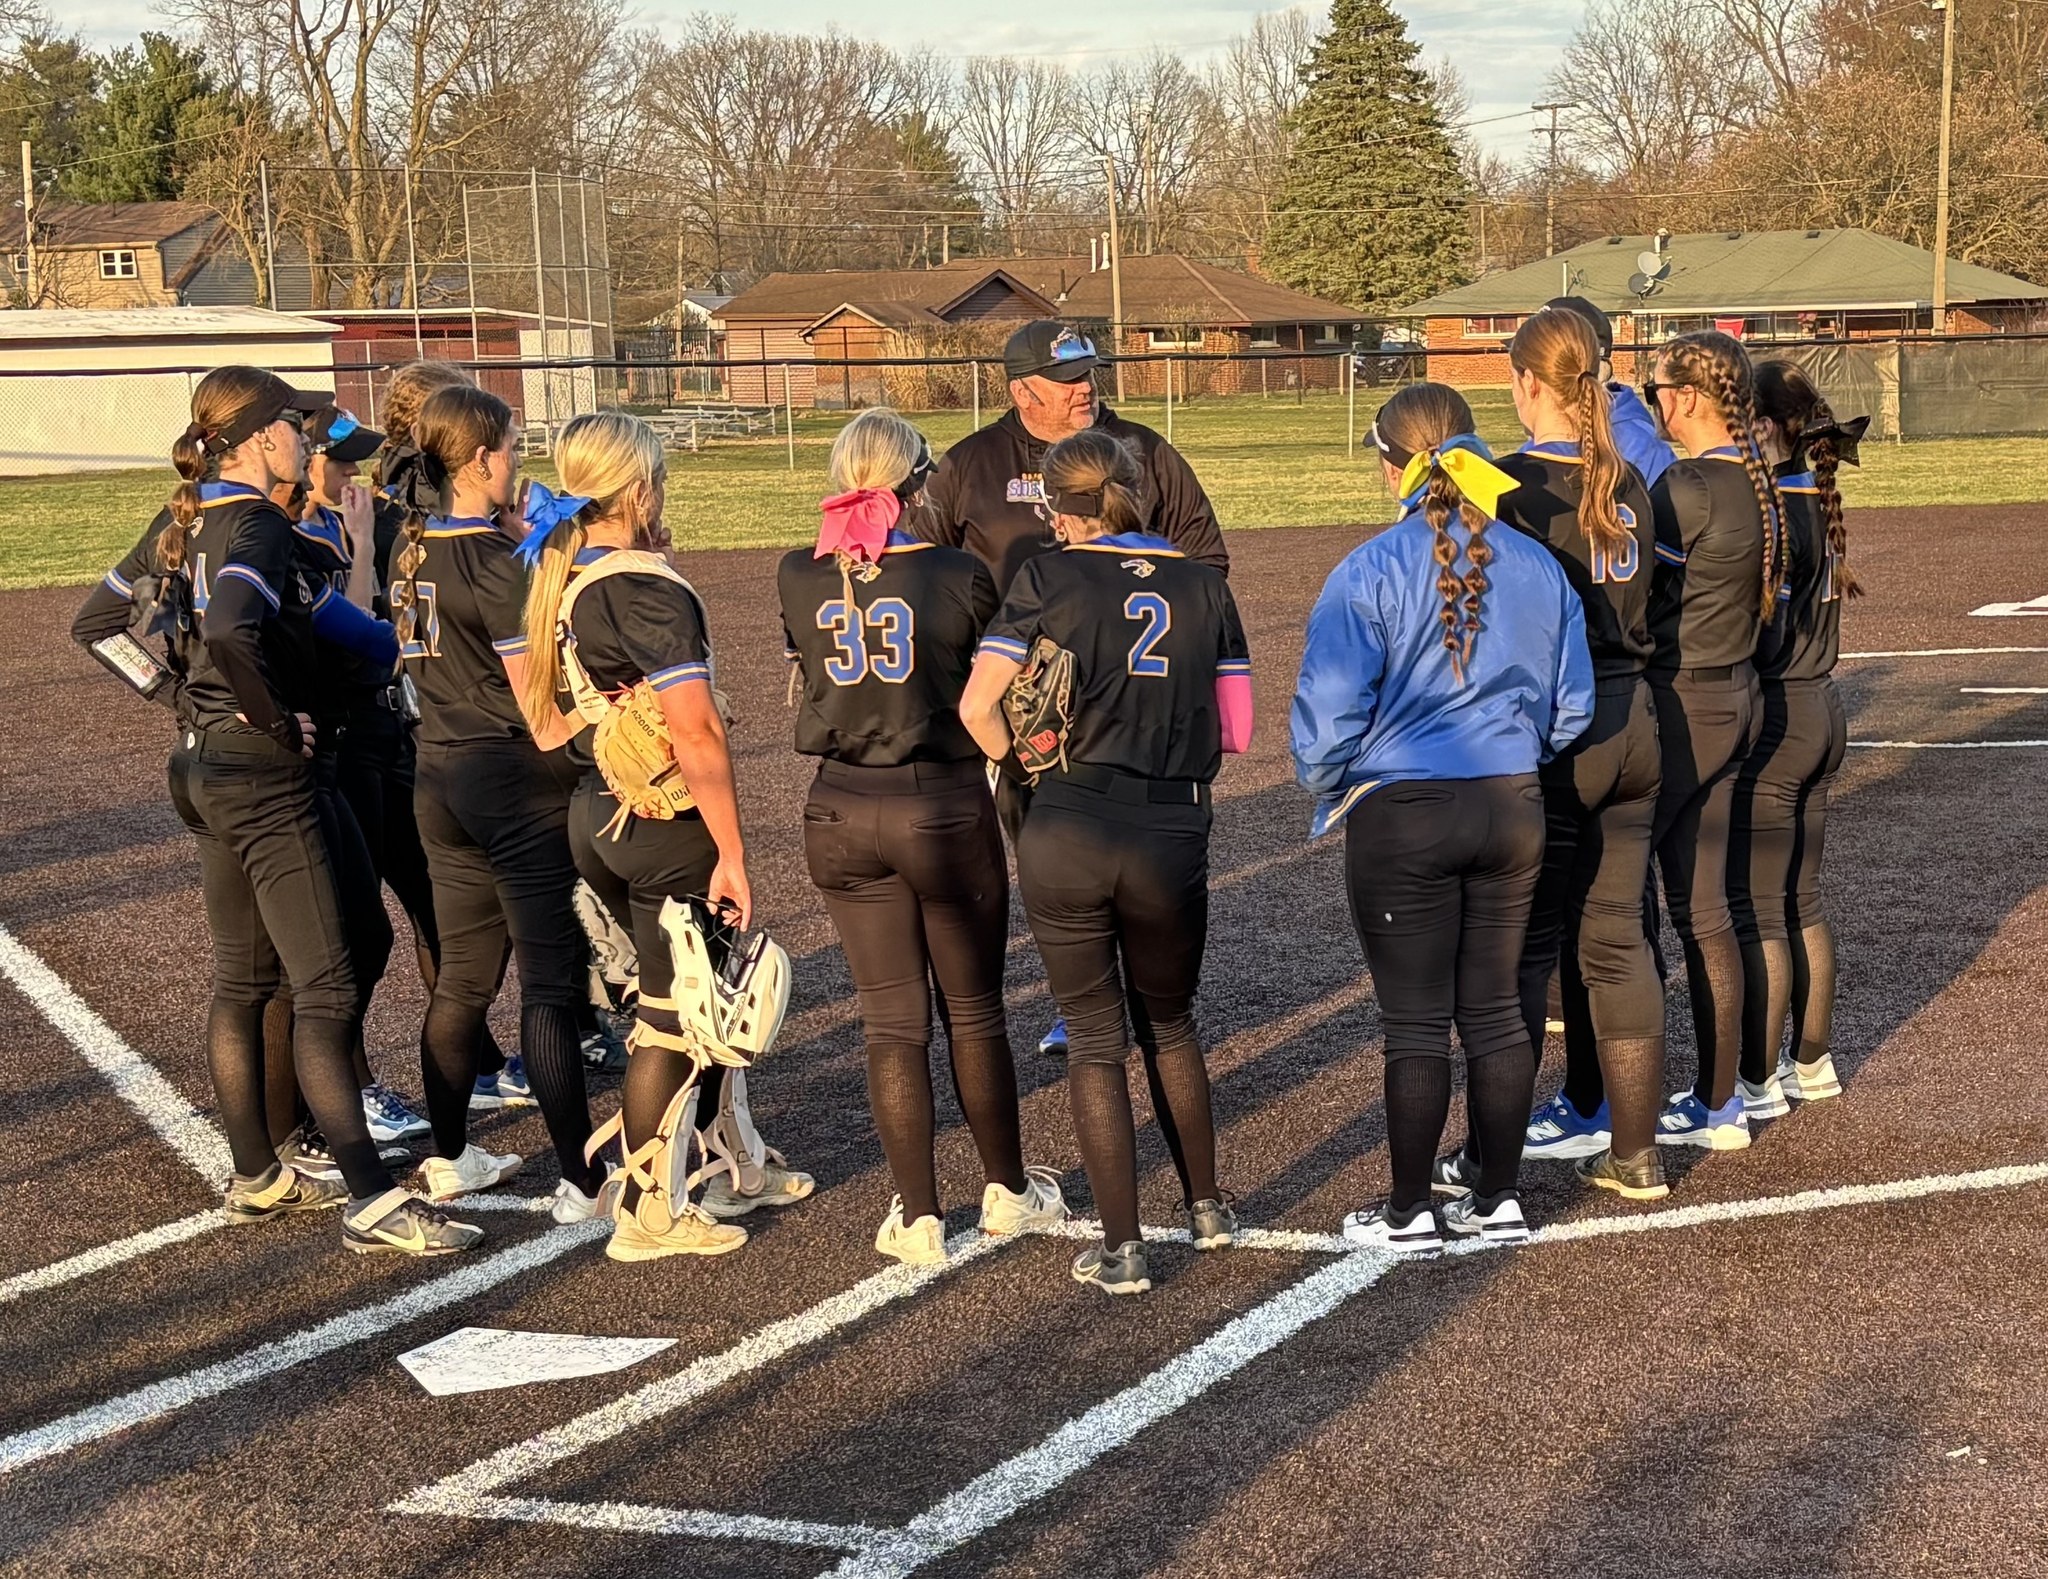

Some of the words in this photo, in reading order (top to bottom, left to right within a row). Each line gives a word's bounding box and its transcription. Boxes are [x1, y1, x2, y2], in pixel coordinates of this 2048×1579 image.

[1585, 503, 1639, 584] 16
[816, 597, 915, 685] 33
[1124, 592, 1171, 677] 2
